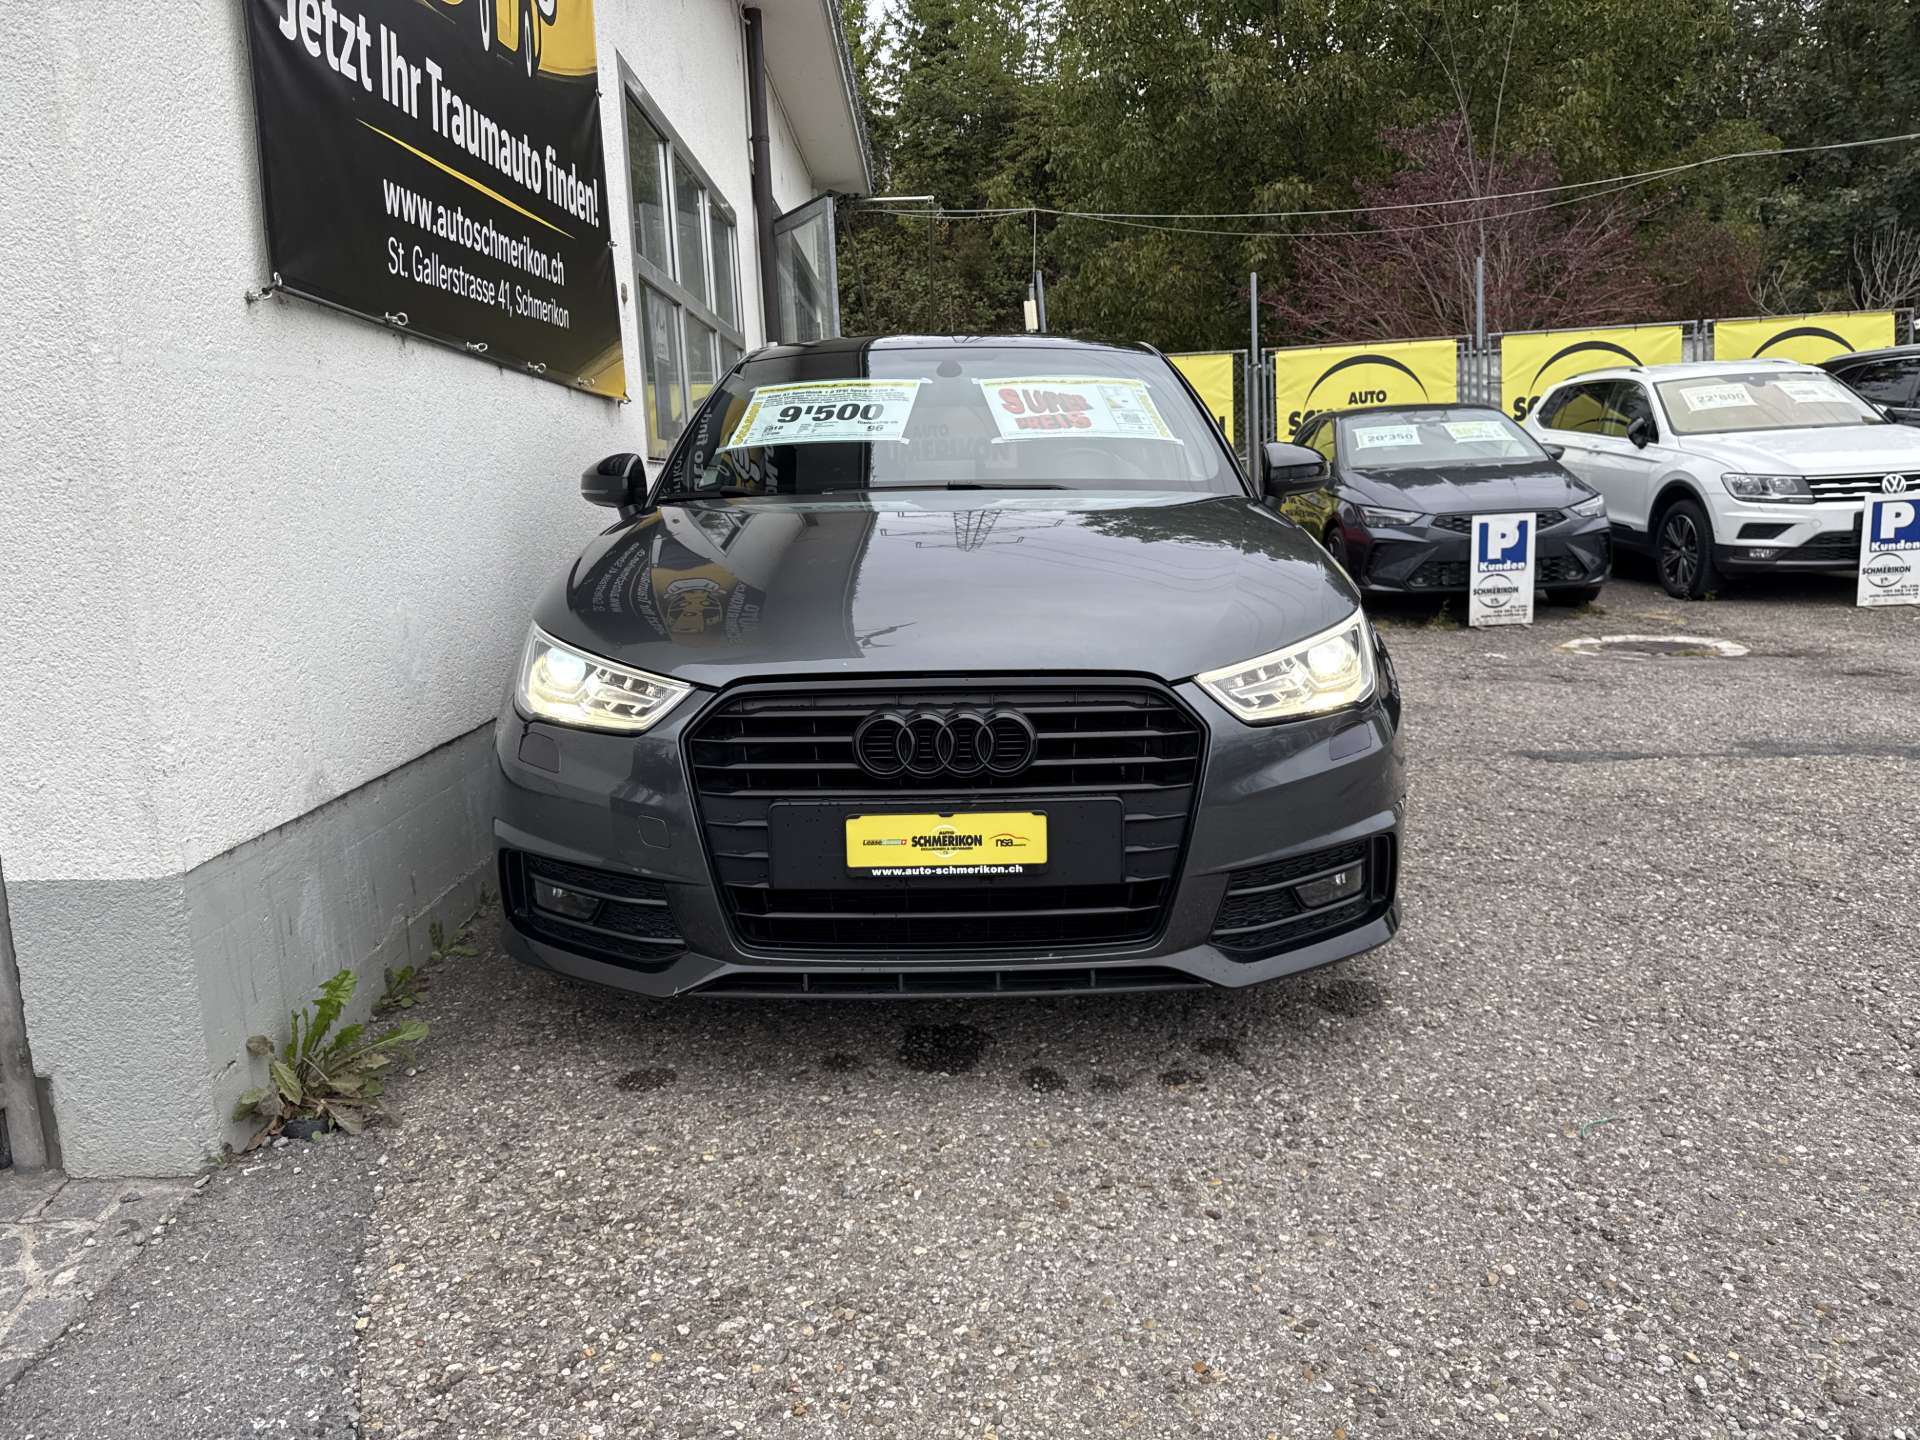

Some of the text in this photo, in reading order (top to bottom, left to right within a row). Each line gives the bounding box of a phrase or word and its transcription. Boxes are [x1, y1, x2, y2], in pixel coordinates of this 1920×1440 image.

[380, 24, 422, 119] Ihr
[426, 57, 543, 194] Traumauto
[545, 145, 601, 228] finden!
[384, 179, 565, 286] www.autoschmerikon.ch
[388, 237, 570, 329] St. Gallerstrasse 41, Schmerikon
[1348, 390, 1387, 404] AUTO
[777, 403, 884, 423] 9'500
[1880, 502, 1915, 539] P
[1487, 520, 1519, 560] P
[1871, 540, 1920, 552] Kunden
[1480, 561, 1525, 571] Kunden
[1862, 565, 1911, 575] SCHMERIKON
[911, 835, 983, 848] SCHMERIKON
[995, 838, 1013, 847] nsa
[871, 864, 1023, 876] www.auto-schmerikon.ch
